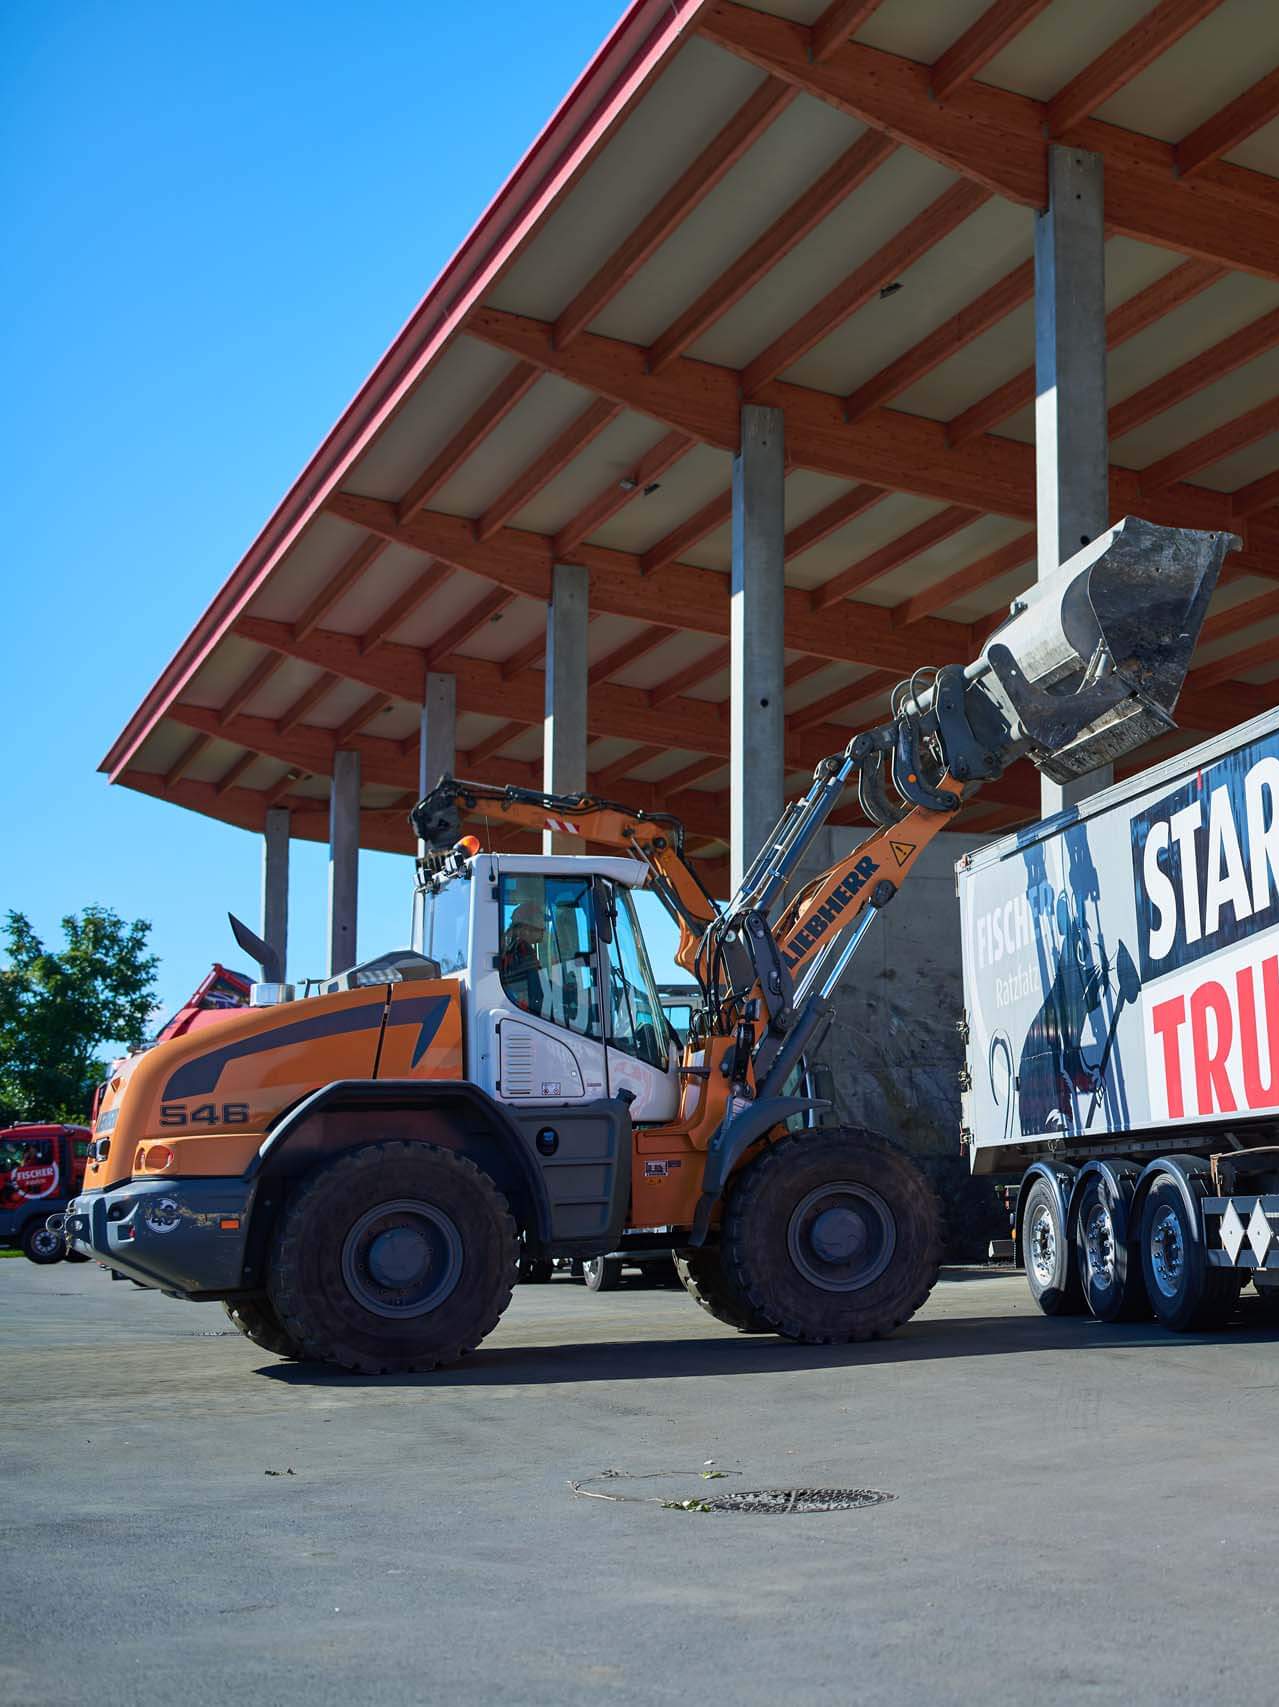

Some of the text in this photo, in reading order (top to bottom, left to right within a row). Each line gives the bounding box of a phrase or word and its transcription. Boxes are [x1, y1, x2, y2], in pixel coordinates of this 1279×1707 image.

[782, 855, 881, 970] LIEBHERR
[976, 880, 1060, 969] FISCHER
[159, 1103, 250, 1127] 546
[17, 1166, 54, 1181] FISCHER
